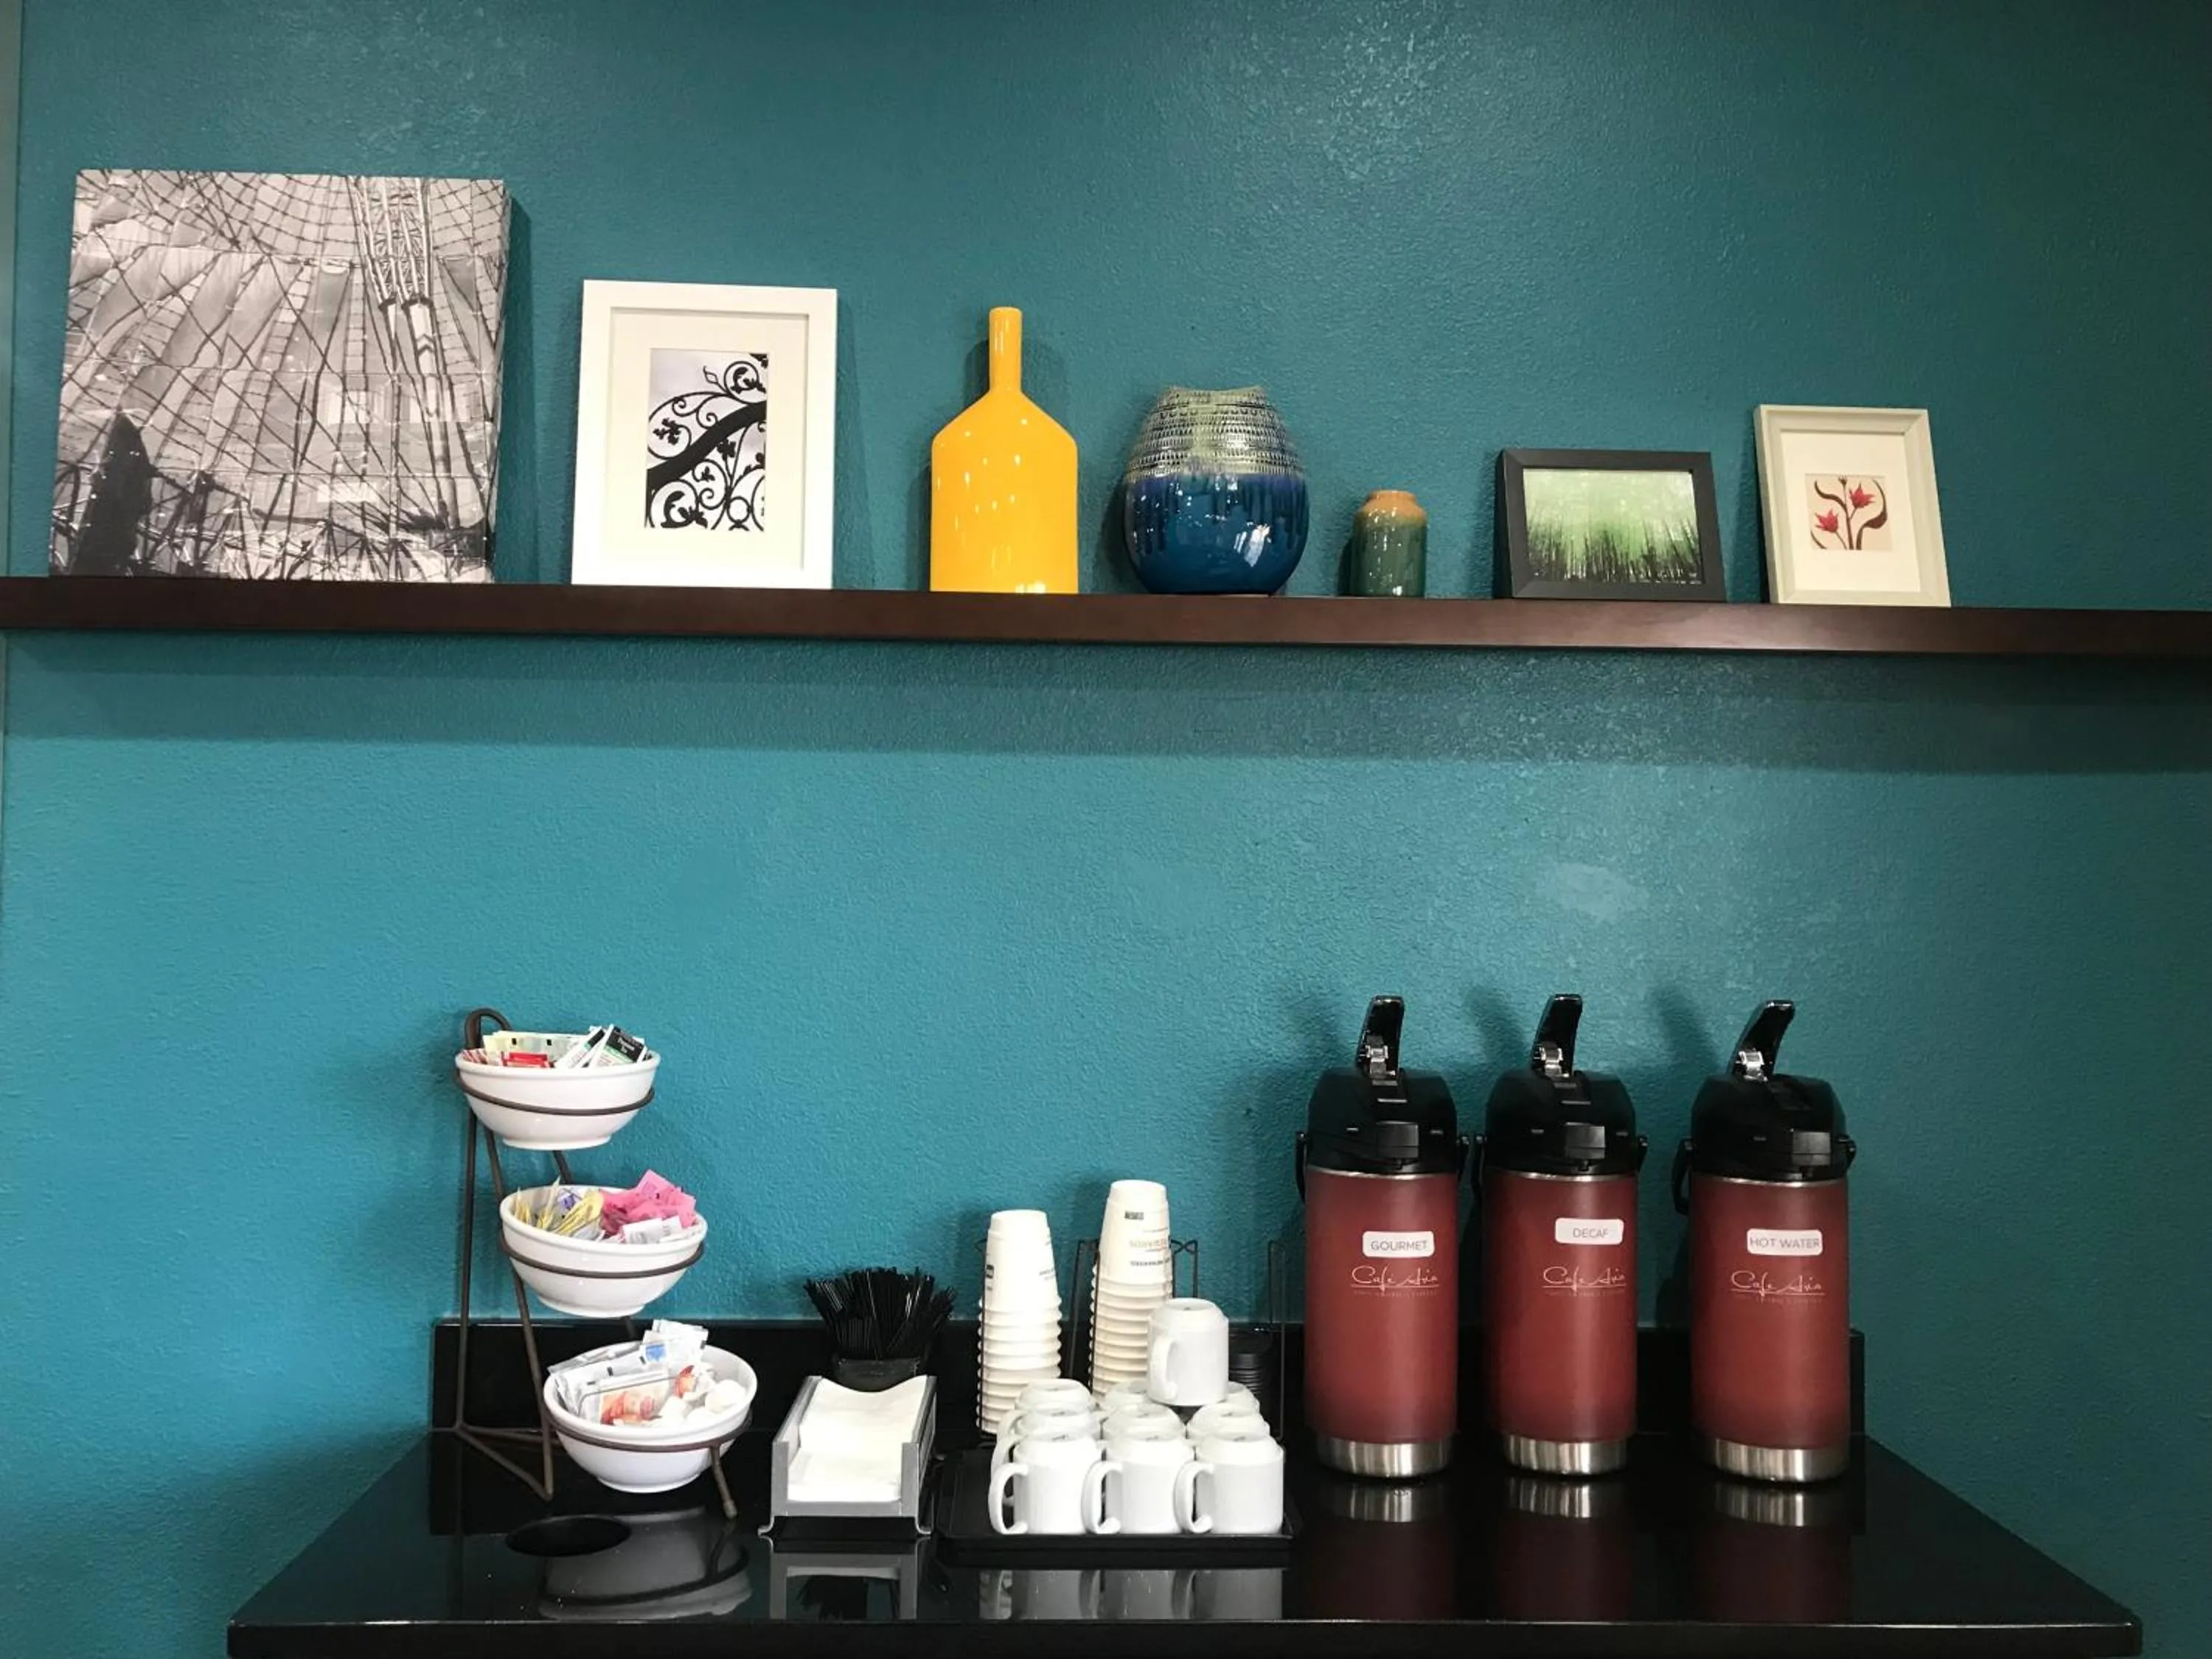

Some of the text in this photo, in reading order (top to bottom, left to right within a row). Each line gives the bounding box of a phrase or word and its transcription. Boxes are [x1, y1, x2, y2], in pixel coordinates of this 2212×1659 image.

[1572, 1228, 1609, 1239] DECAF
[1371, 1239, 1427, 1251] GOURMET
[1750, 1237, 1820, 1249] HOT WATER
